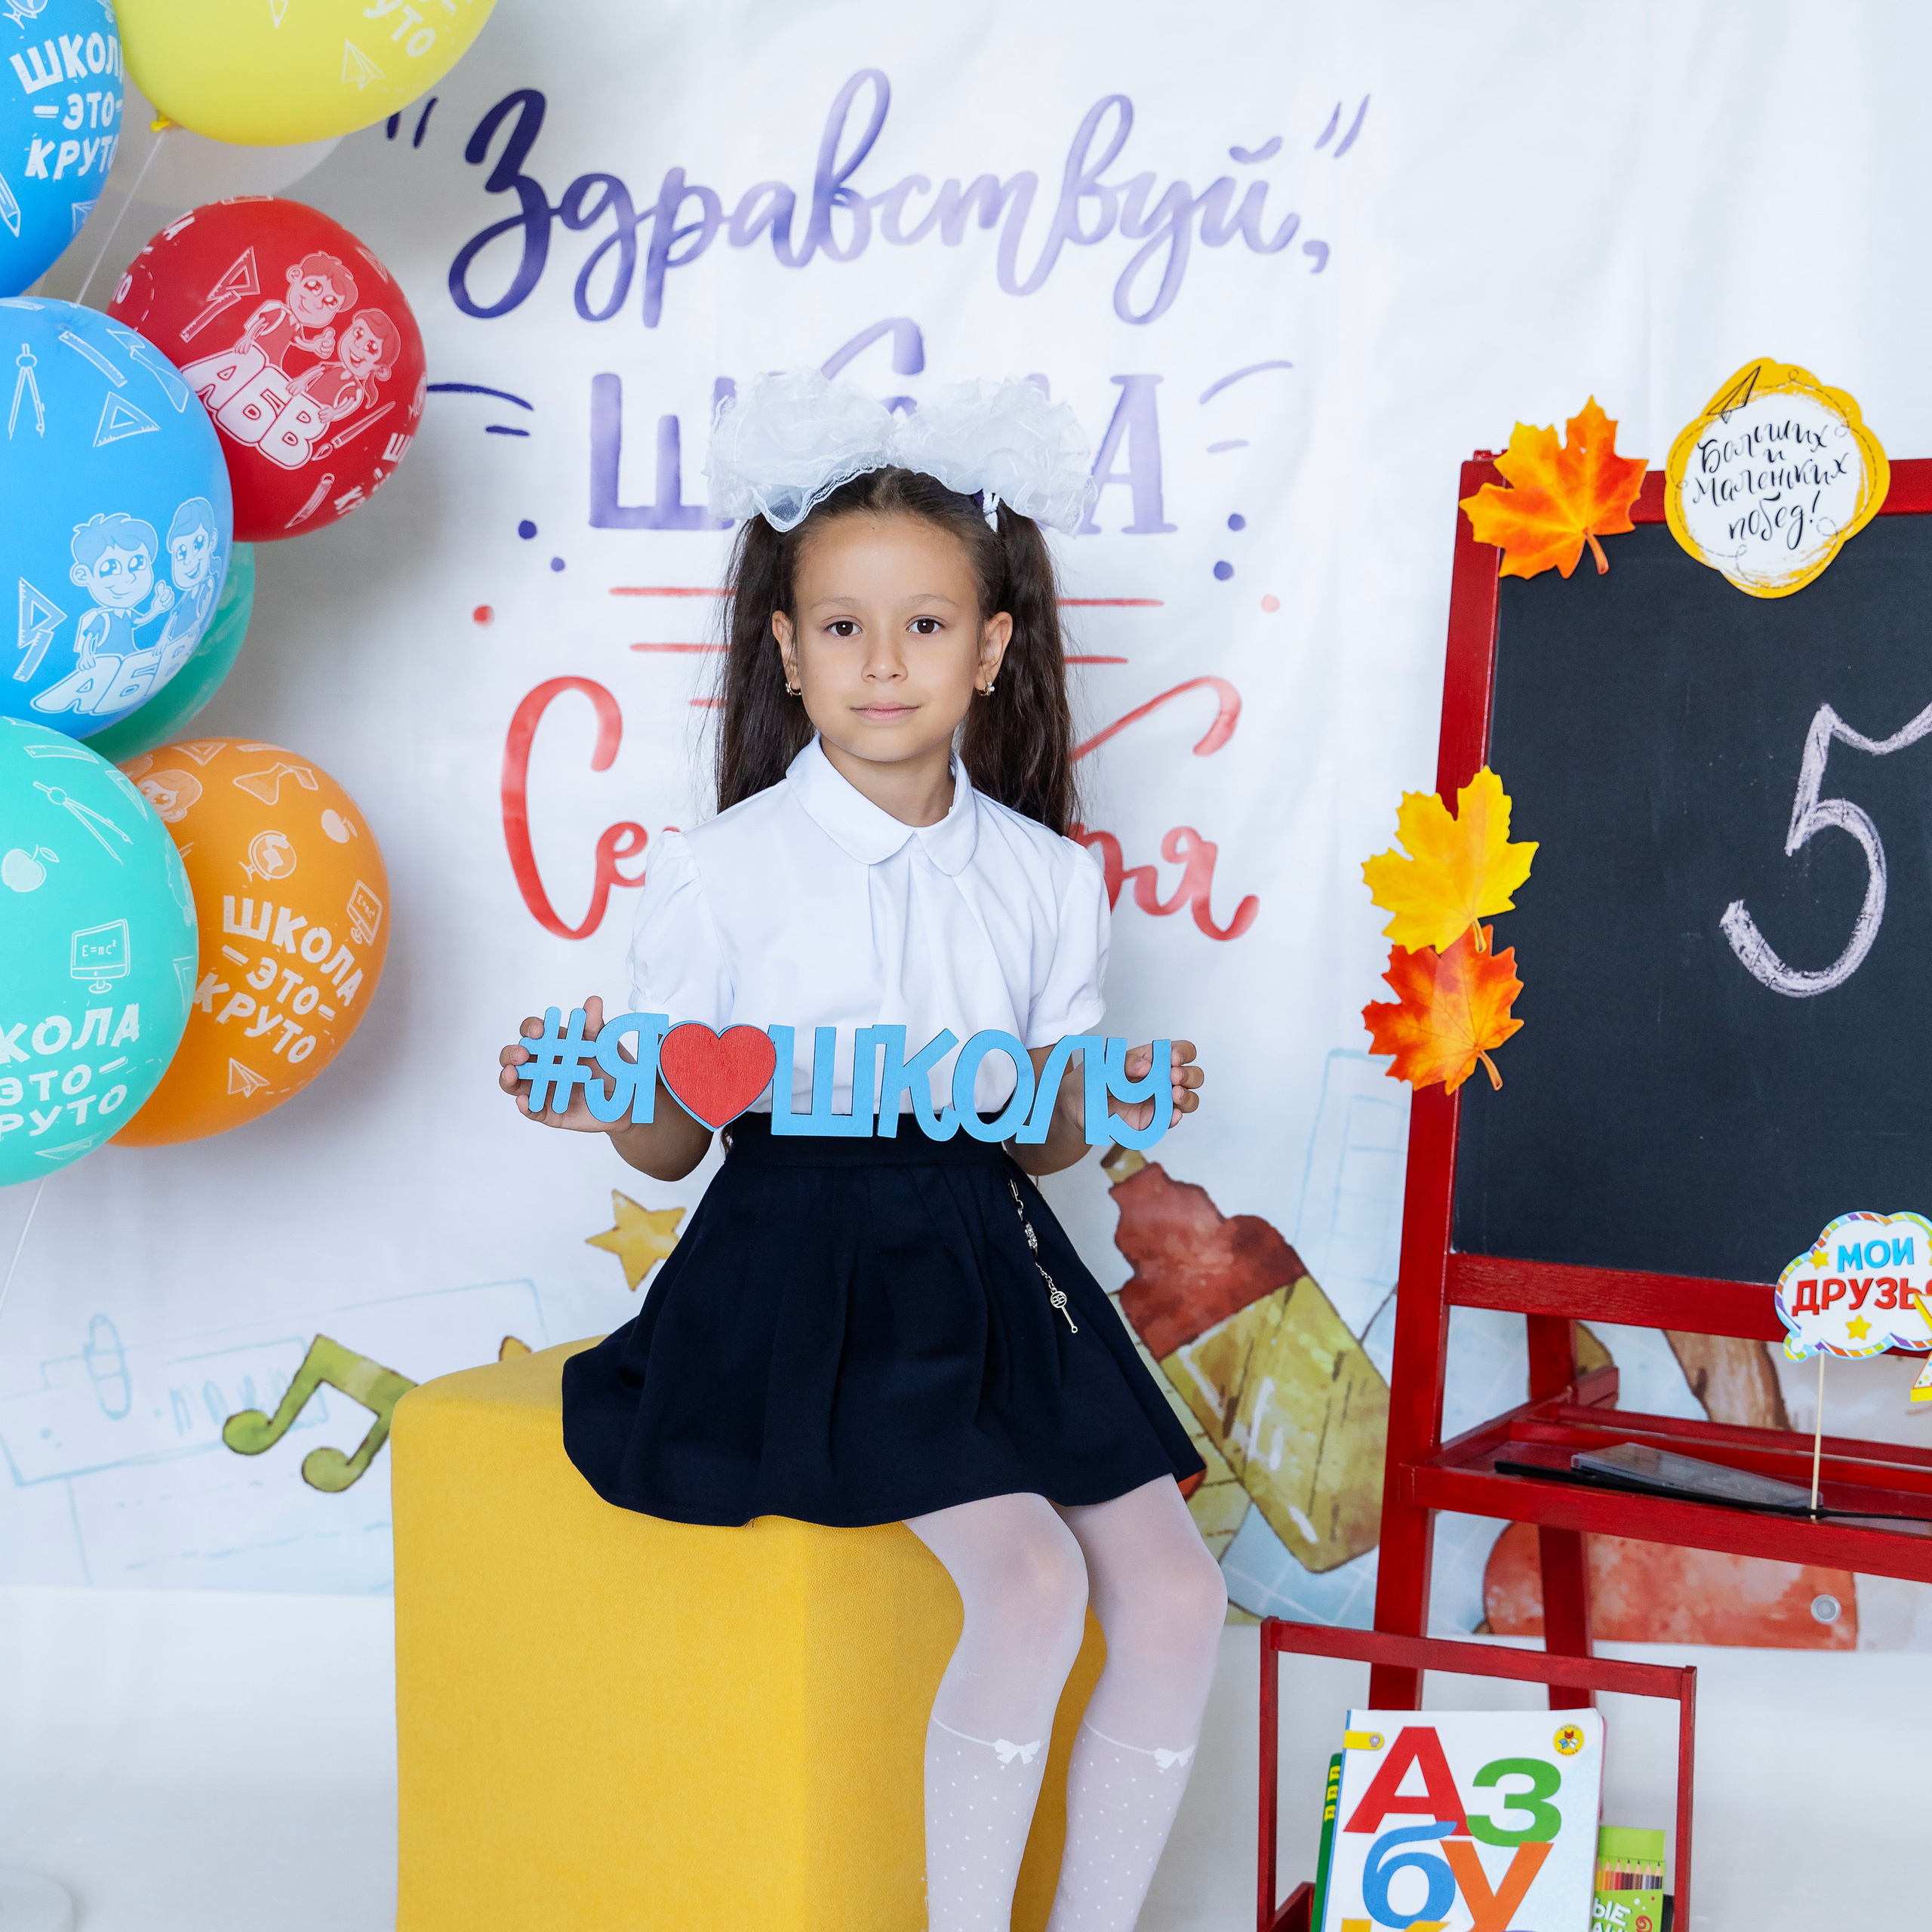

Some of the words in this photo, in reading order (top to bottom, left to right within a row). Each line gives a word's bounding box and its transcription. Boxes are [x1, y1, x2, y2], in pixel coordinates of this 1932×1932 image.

[178, 341, 331, 470] АБВ
[1764, 448, 1786, 463] и
[1729, 491, 1821, 550] побед!
[1720, 703, 1932, 998] 5
[223, 895, 364, 1007] ШКОЛА
[193, 972, 316, 1063] КРУТО
[1838, 1237, 1915, 1272] МОИ
[1792, 1277, 1932, 1317] ДРУЗЬ
